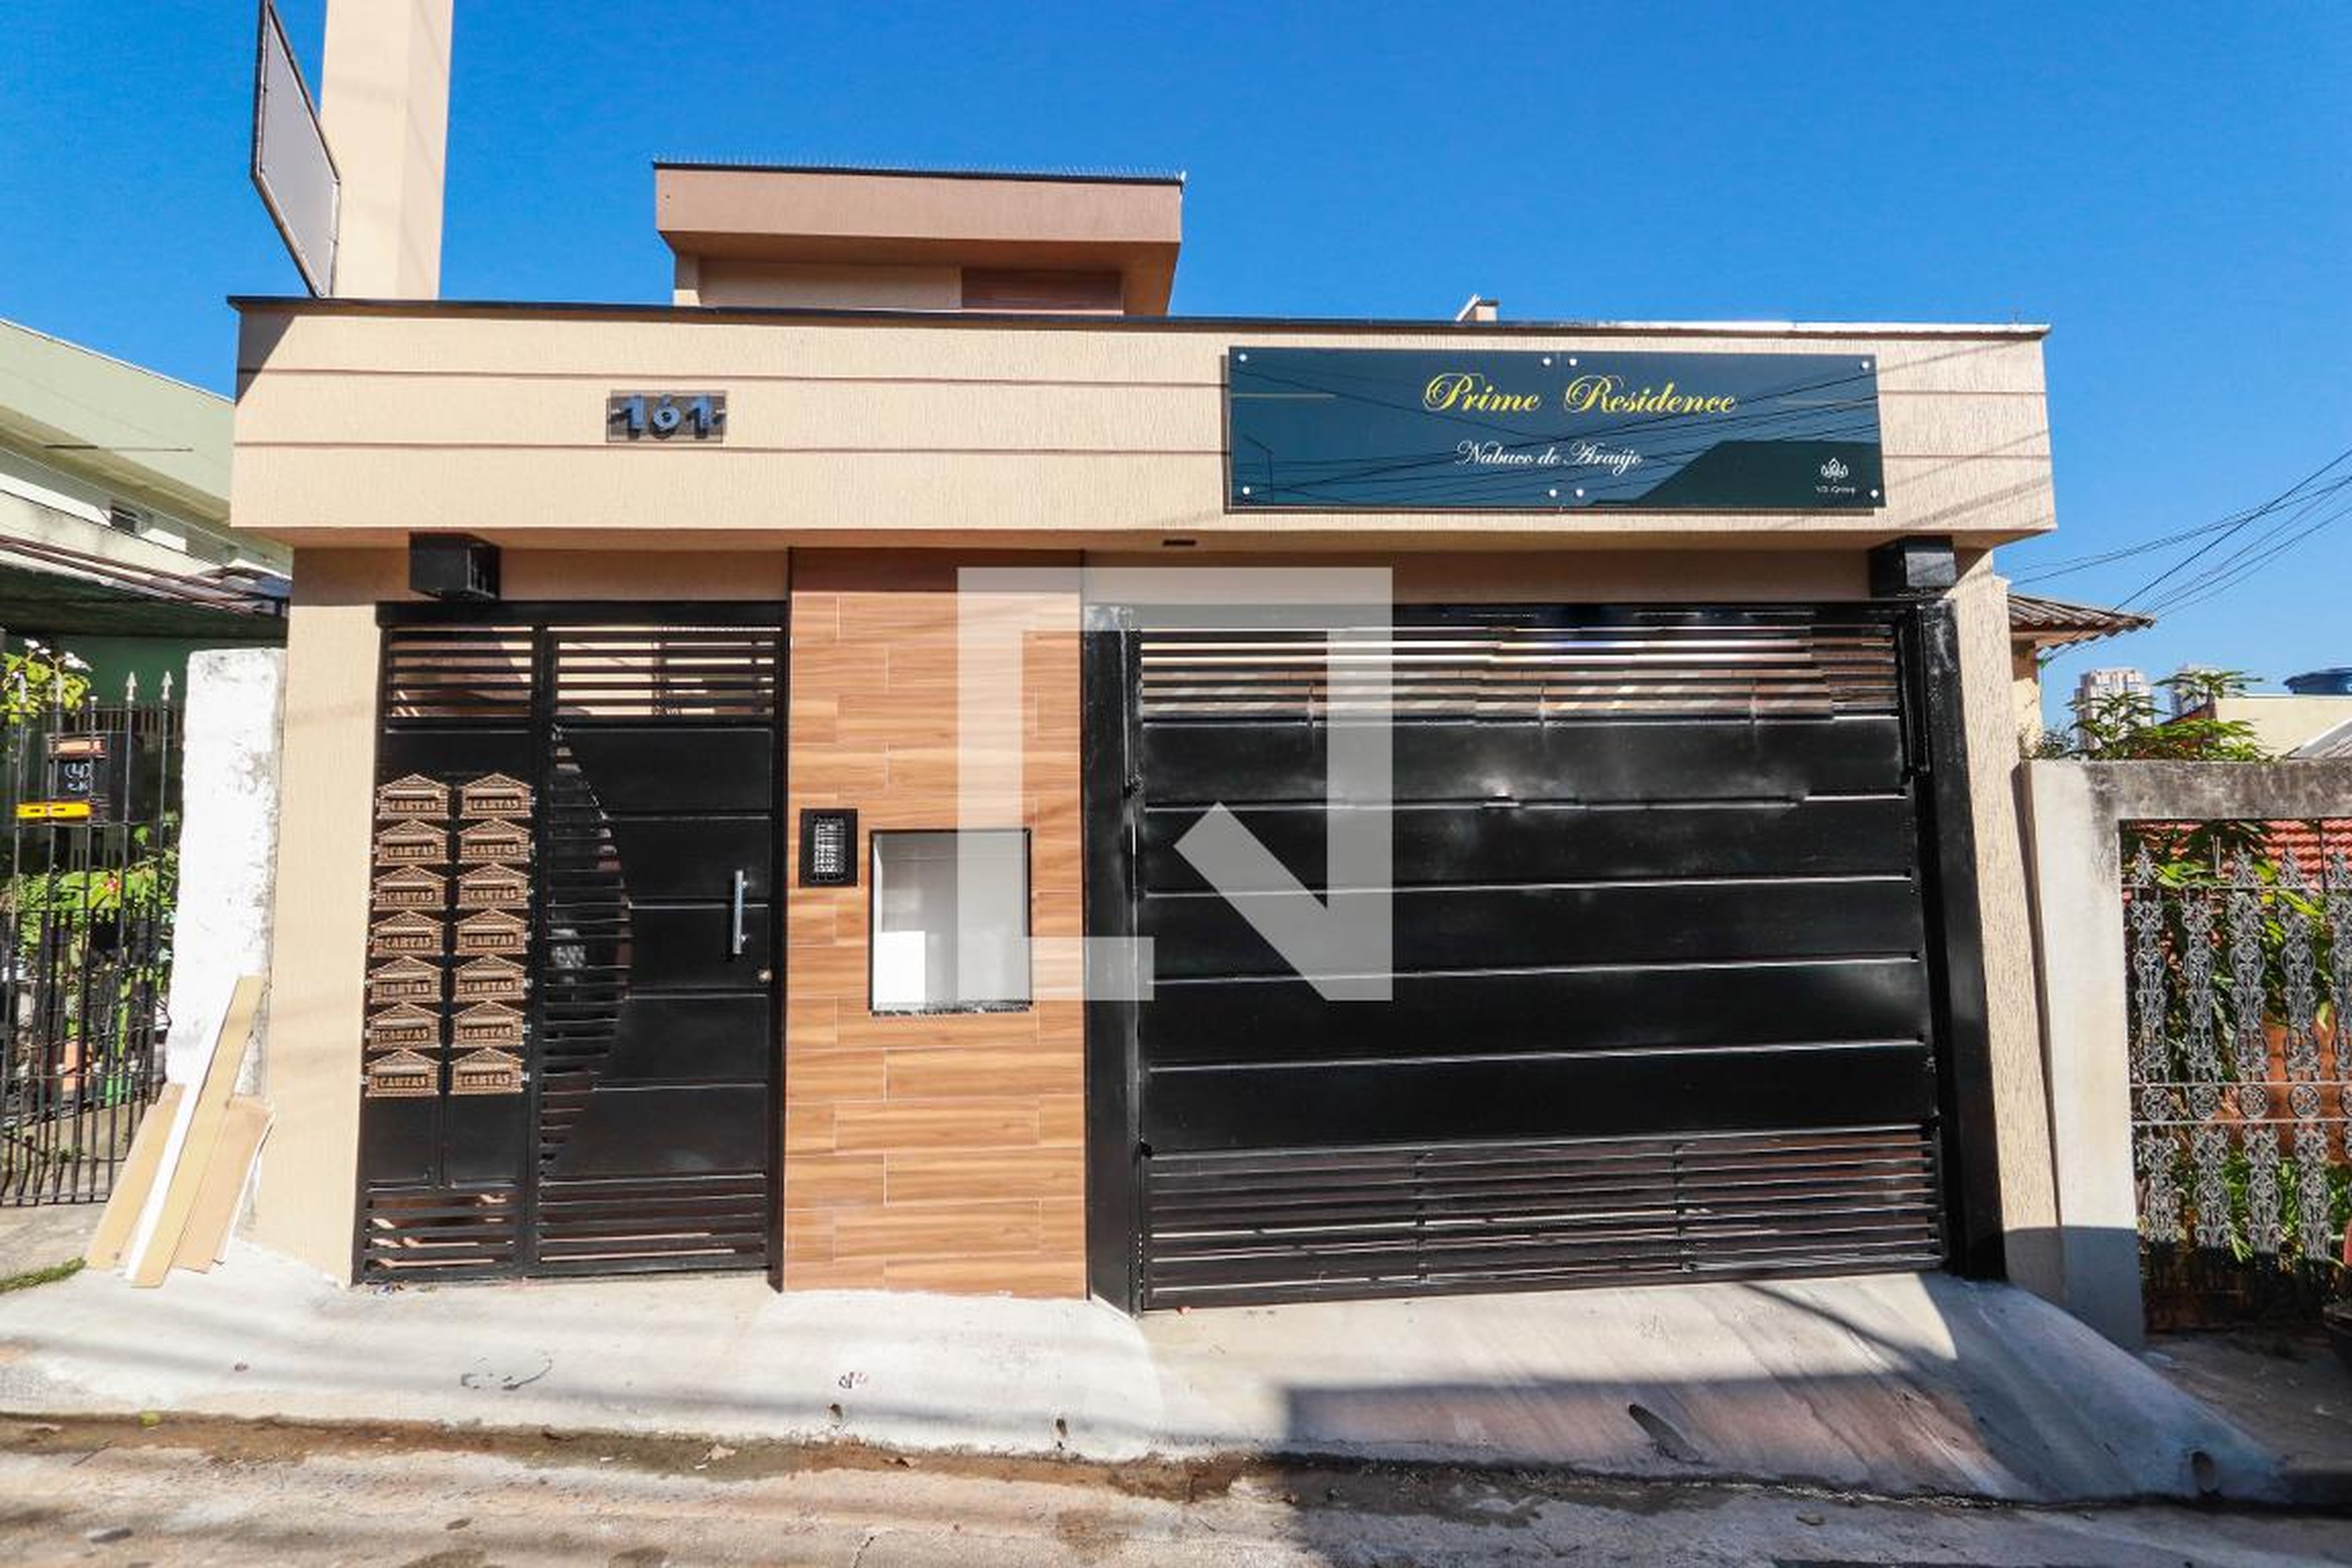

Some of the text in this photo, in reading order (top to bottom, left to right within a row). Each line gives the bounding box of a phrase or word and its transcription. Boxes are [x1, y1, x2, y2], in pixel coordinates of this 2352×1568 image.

[1423, 373, 1740, 413] Prime Residence
[621, 391, 713, 434] 161
[1455, 440, 1644, 477] Nabuco de Araújo
[390, 800, 437, 811] CARTAS
[472, 799, 519, 809] CARTAS
[389, 845, 436, 857] CARTAS
[472, 844, 518, 855] CARTAS
[386, 891, 434, 902] CARTAS
[469, 889, 516, 900] CARTAS
[385, 936, 432, 949] CARTAS
[468, 935, 514, 946] CARTAS
[382, 981, 430, 994] CARTAS
[466, 980, 514, 992] CARTAS
[380, 1028, 428, 1040] CARTAS
[465, 1027, 513, 1038] CARTAS
[379, 1076, 427, 1088] CARTAS
[463, 1074, 510, 1085] CARTAS
